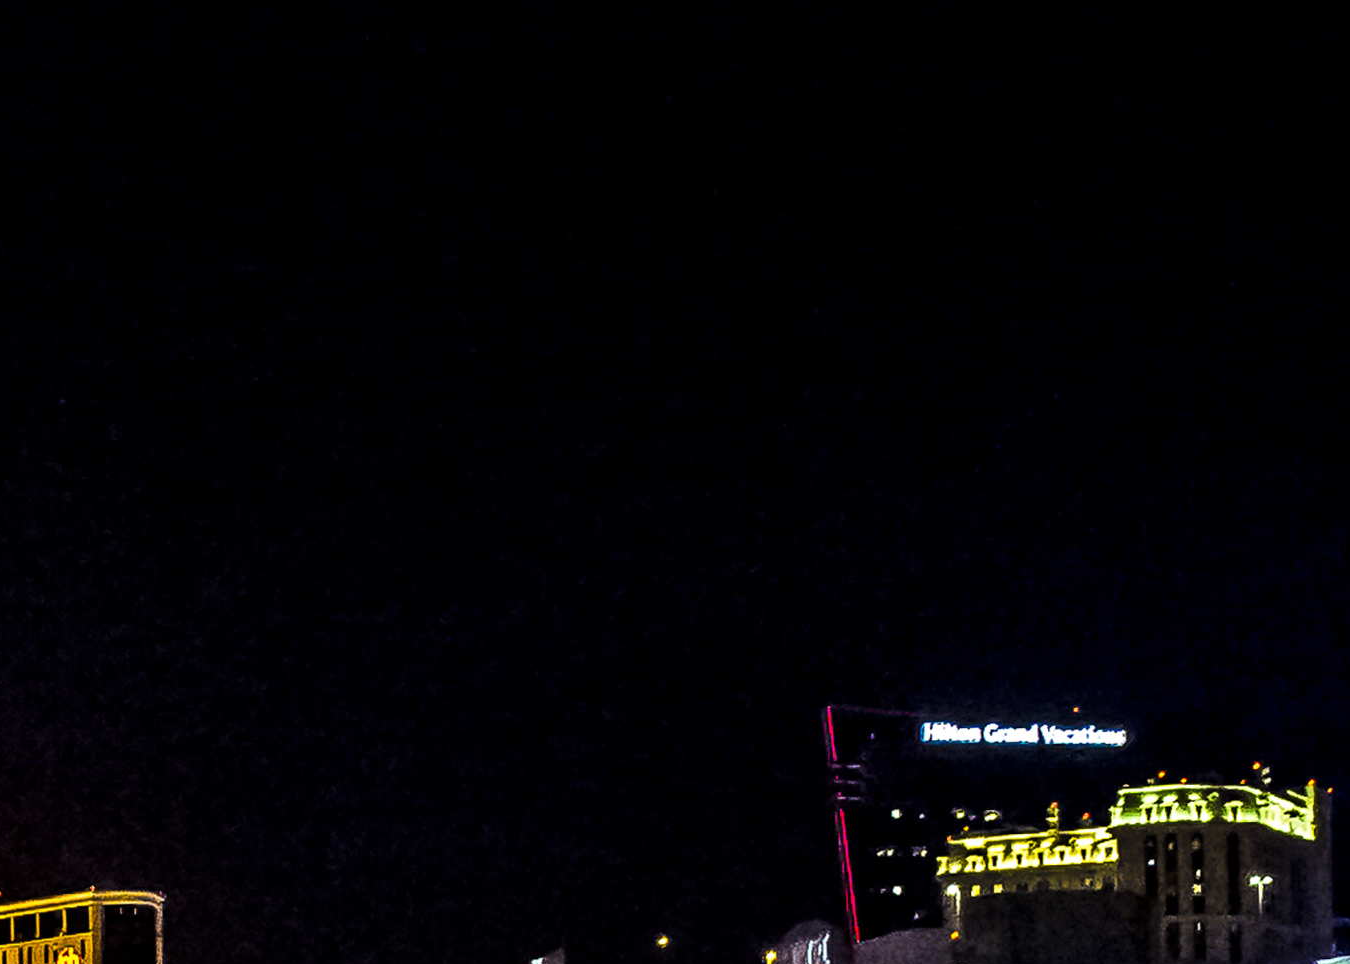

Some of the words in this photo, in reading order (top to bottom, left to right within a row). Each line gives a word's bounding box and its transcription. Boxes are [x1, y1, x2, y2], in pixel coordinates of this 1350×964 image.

[921, 722, 982, 743] Hilton
[983, 723, 1039, 743] Grand
[1040, 725, 1127, 746] Vacations
